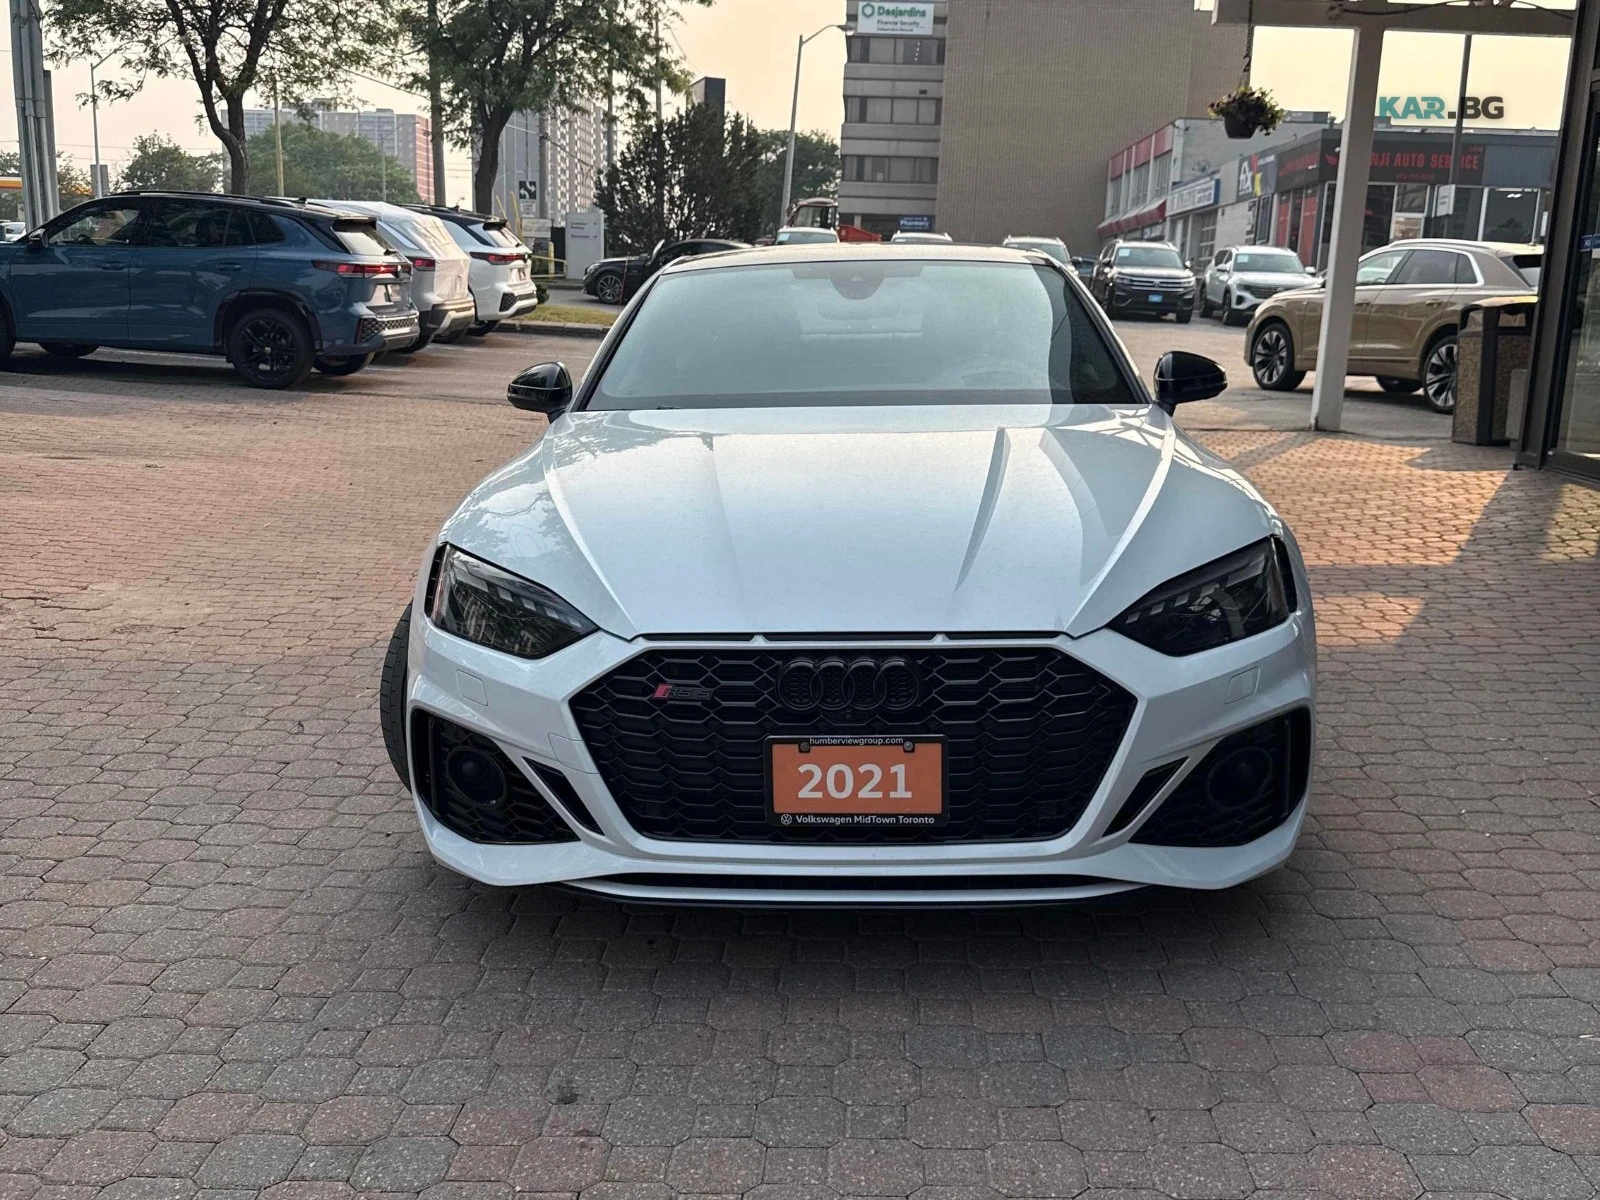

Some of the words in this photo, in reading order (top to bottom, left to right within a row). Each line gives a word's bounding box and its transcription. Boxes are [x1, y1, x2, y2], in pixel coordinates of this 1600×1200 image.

[877, 6, 926, 18] Desjardins
[1394, 152, 1425, 168] AUTO
[1430, 153, 1479, 170] SERICE
[809, 737, 904, 746] humberviewgroup.com
[797, 763, 913, 799] 2021
[796, 815, 852, 825] Volkswagen
[853, 815, 896, 824] MidTown
[897, 815, 935, 824] Toronto
